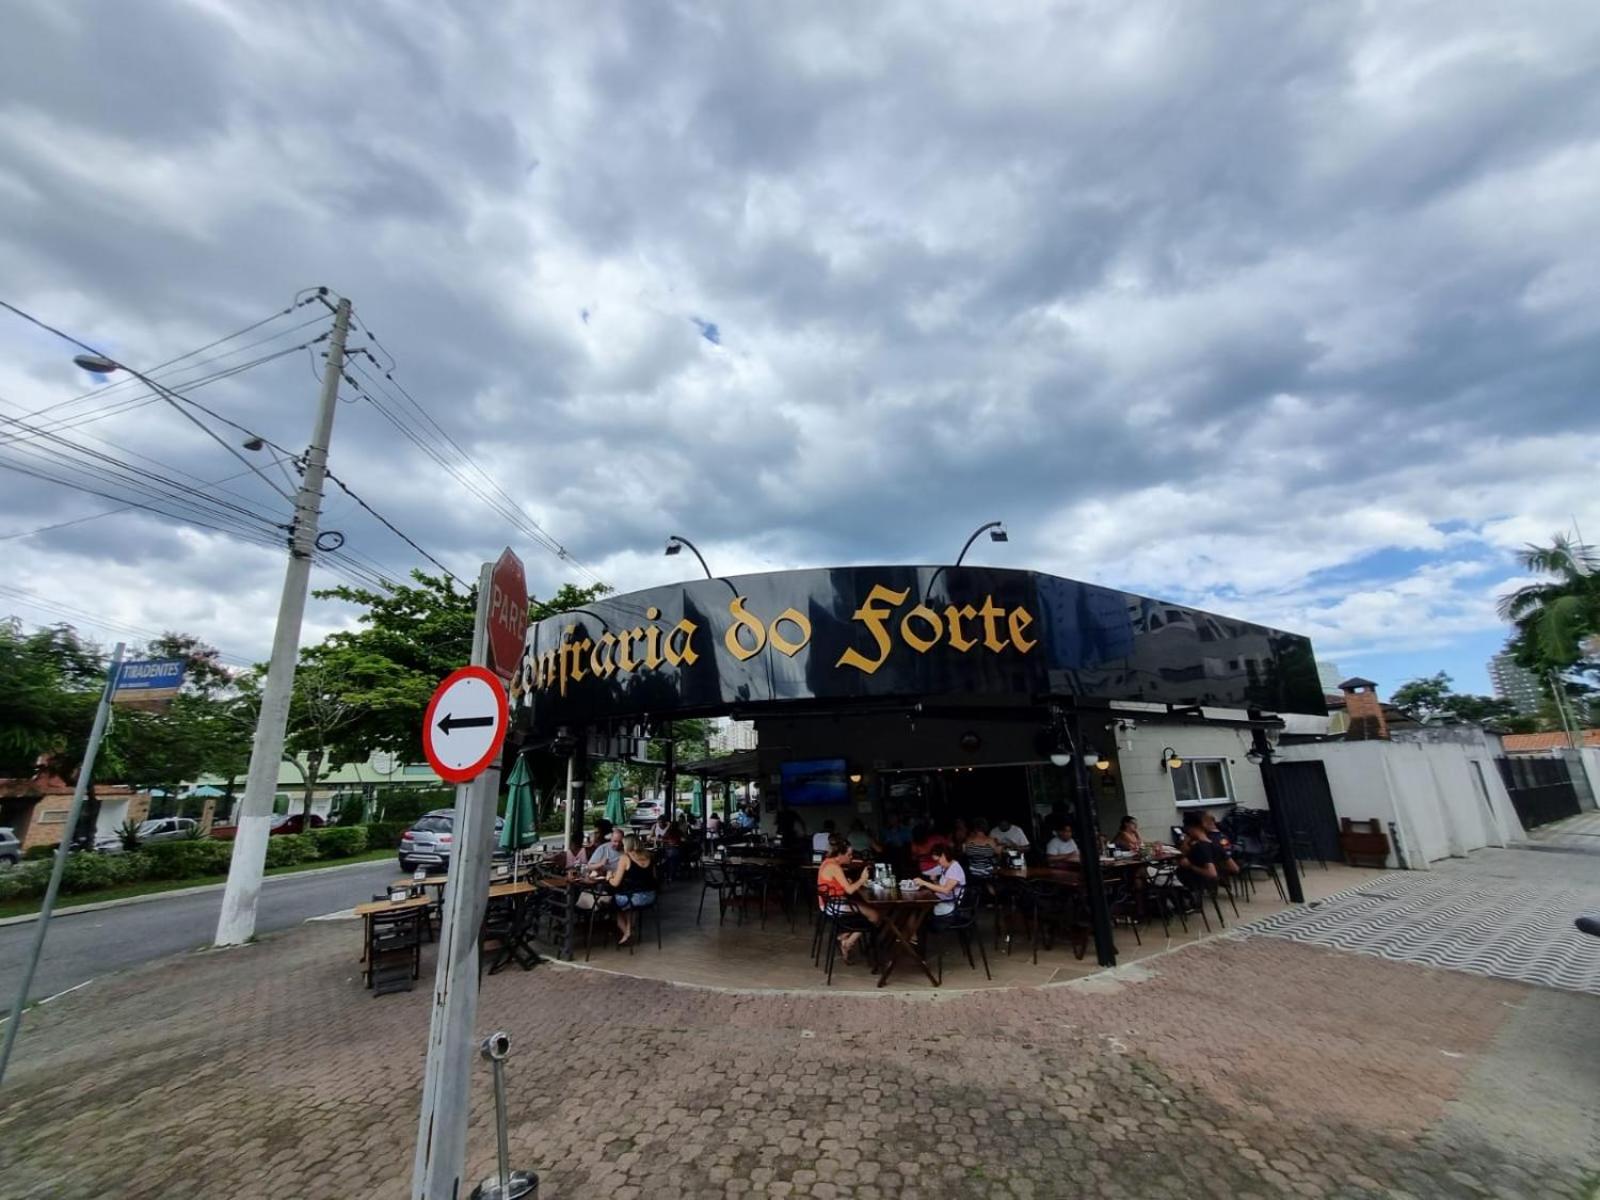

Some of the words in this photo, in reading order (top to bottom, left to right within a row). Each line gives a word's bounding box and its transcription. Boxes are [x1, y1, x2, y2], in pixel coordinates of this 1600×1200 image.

[491, 583, 527, 641] PARE
[724, 595, 812, 662] do
[835, 584, 1038, 675] Forte
[123, 662, 180, 679] TIRADENTES
